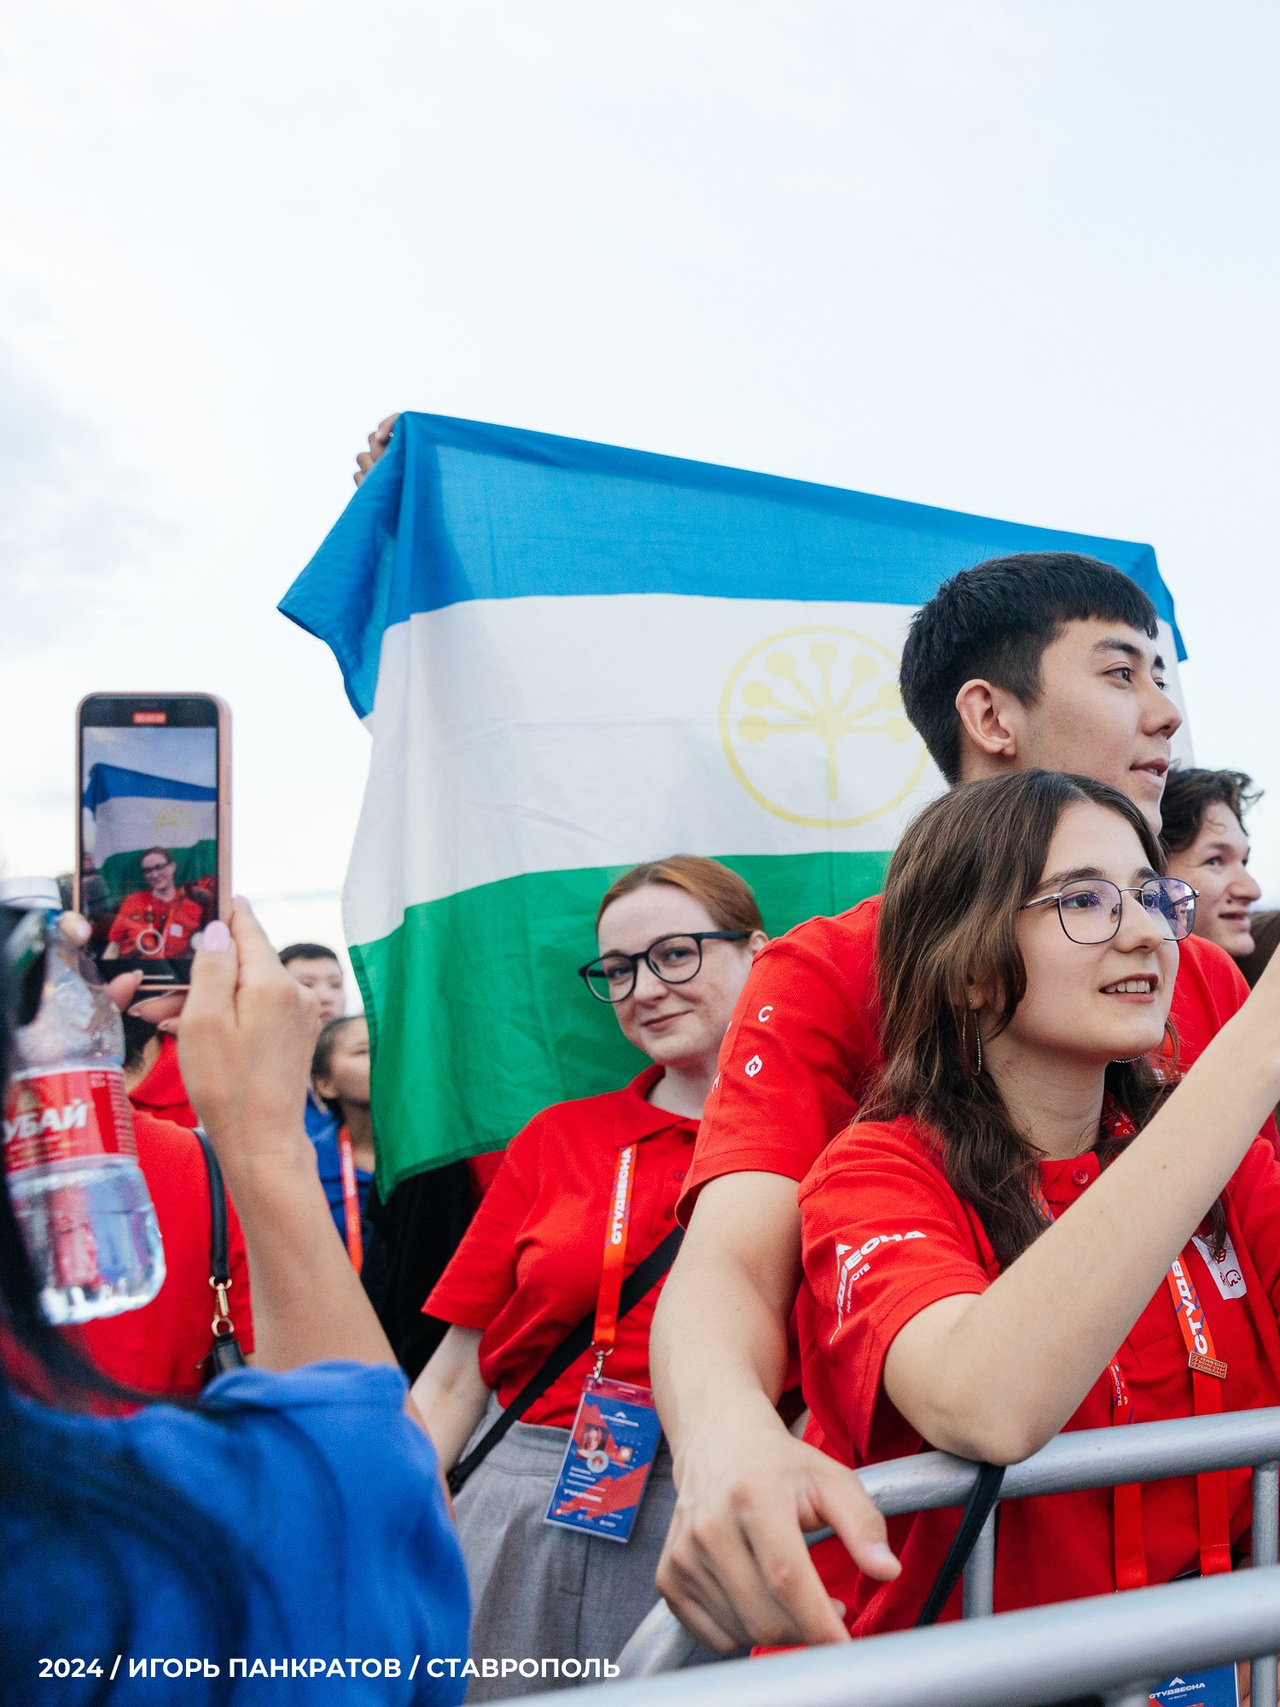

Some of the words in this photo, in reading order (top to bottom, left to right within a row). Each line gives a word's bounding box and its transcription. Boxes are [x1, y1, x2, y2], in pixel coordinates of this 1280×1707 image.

[611, 1147, 632, 1245] СТУДВЕСНА
[1171, 1256, 1208, 1355] СТУДВ
[1149, 1682, 1206, 1699] СТУДВЕСНА
